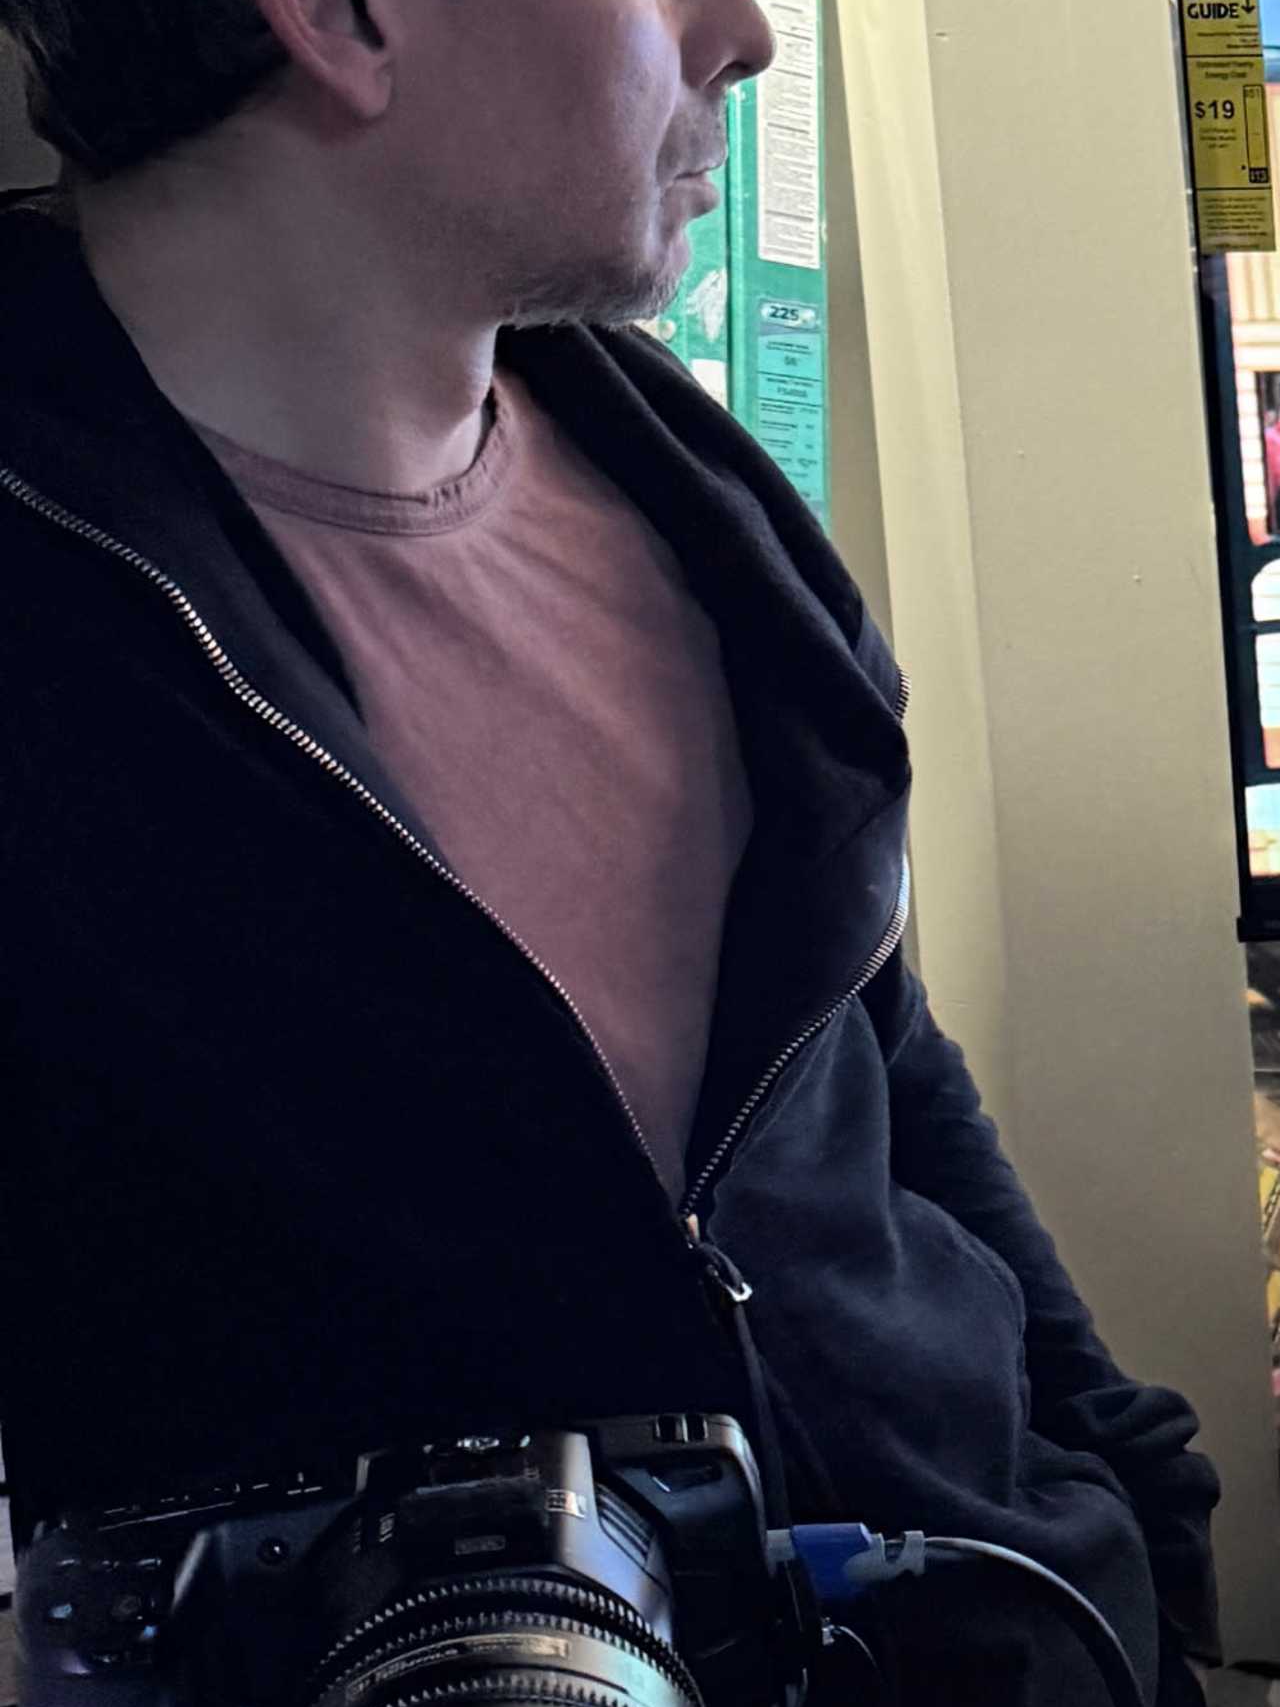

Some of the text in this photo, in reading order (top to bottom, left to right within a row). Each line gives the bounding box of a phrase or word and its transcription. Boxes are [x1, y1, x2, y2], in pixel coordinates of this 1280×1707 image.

[1187, 3, 1240, 19] GUIDE
[1194, 99, 1236, 120] $19
[769, 305, 800, 321] 225
